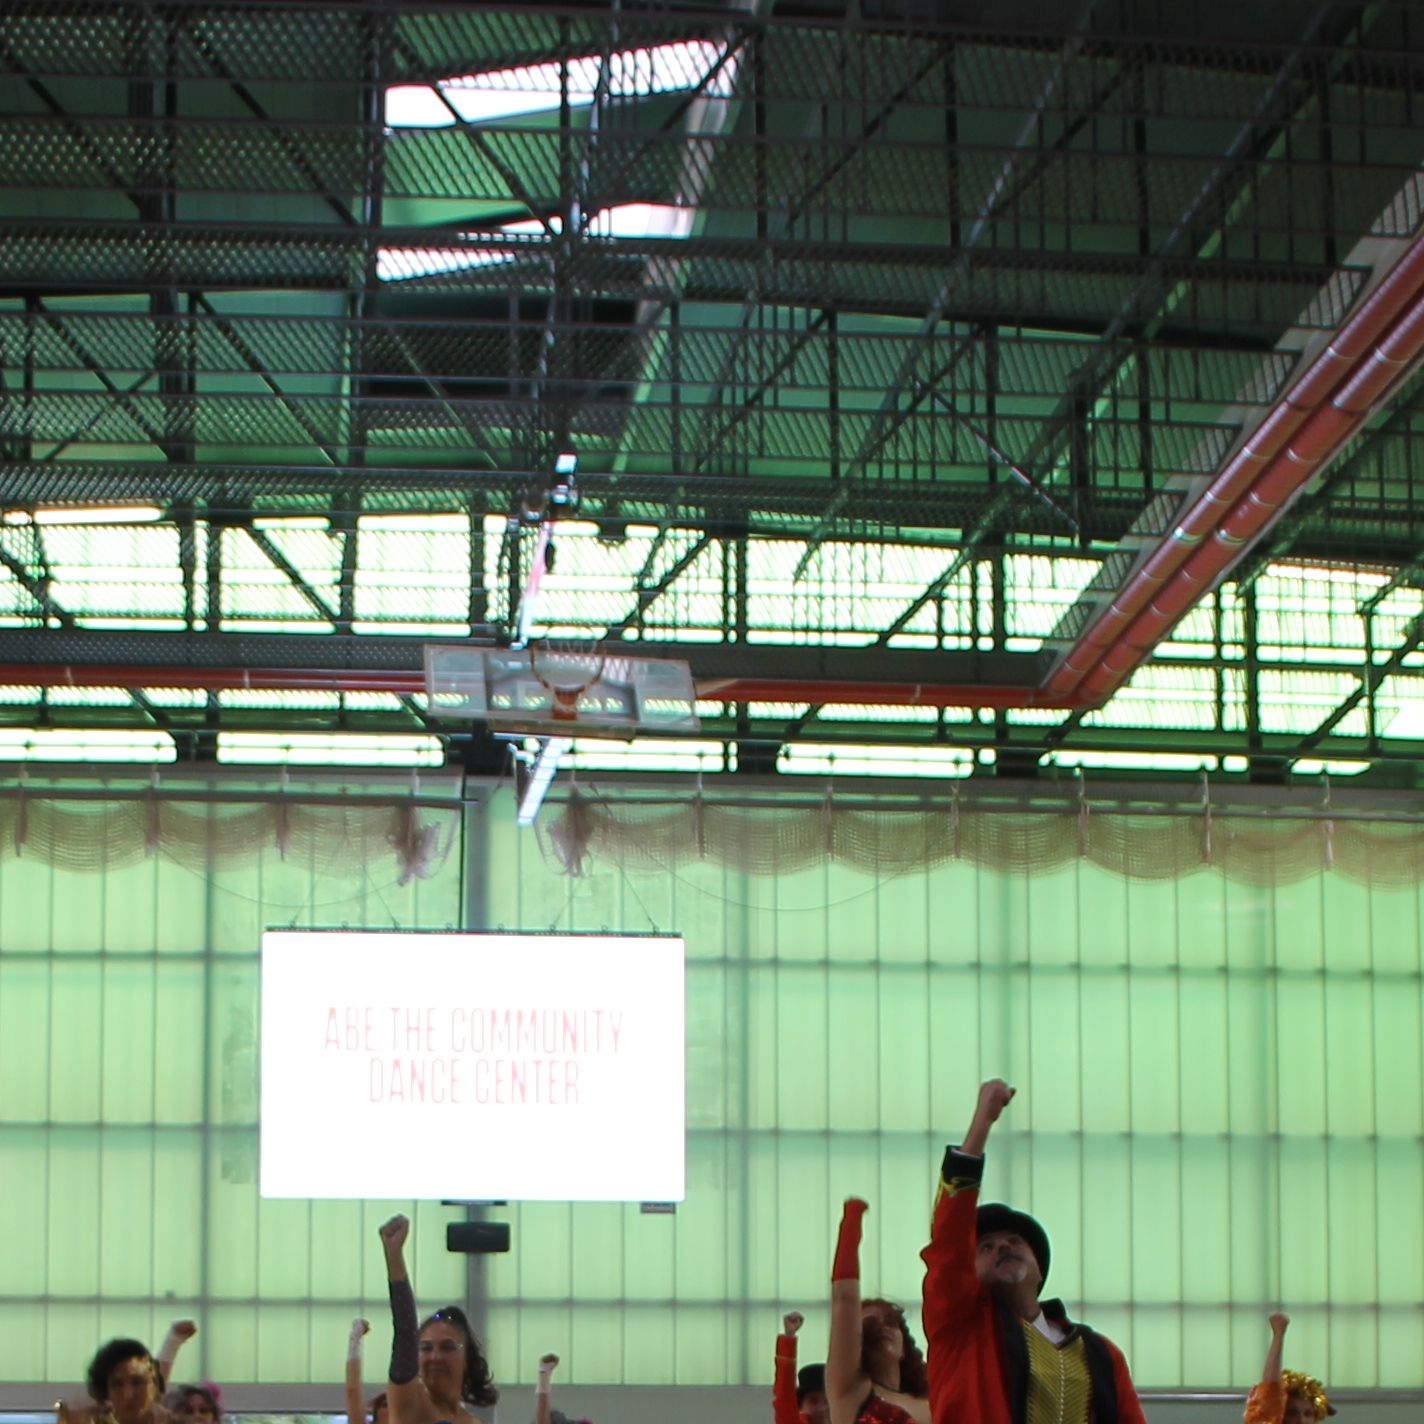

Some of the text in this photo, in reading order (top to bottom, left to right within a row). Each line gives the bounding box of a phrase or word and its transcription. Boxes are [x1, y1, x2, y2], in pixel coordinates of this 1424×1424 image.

[324, 1007, 624, 1054] ABE THE COMMUNITY
[369, 1058, 582, 1105] DANCE CENTER
